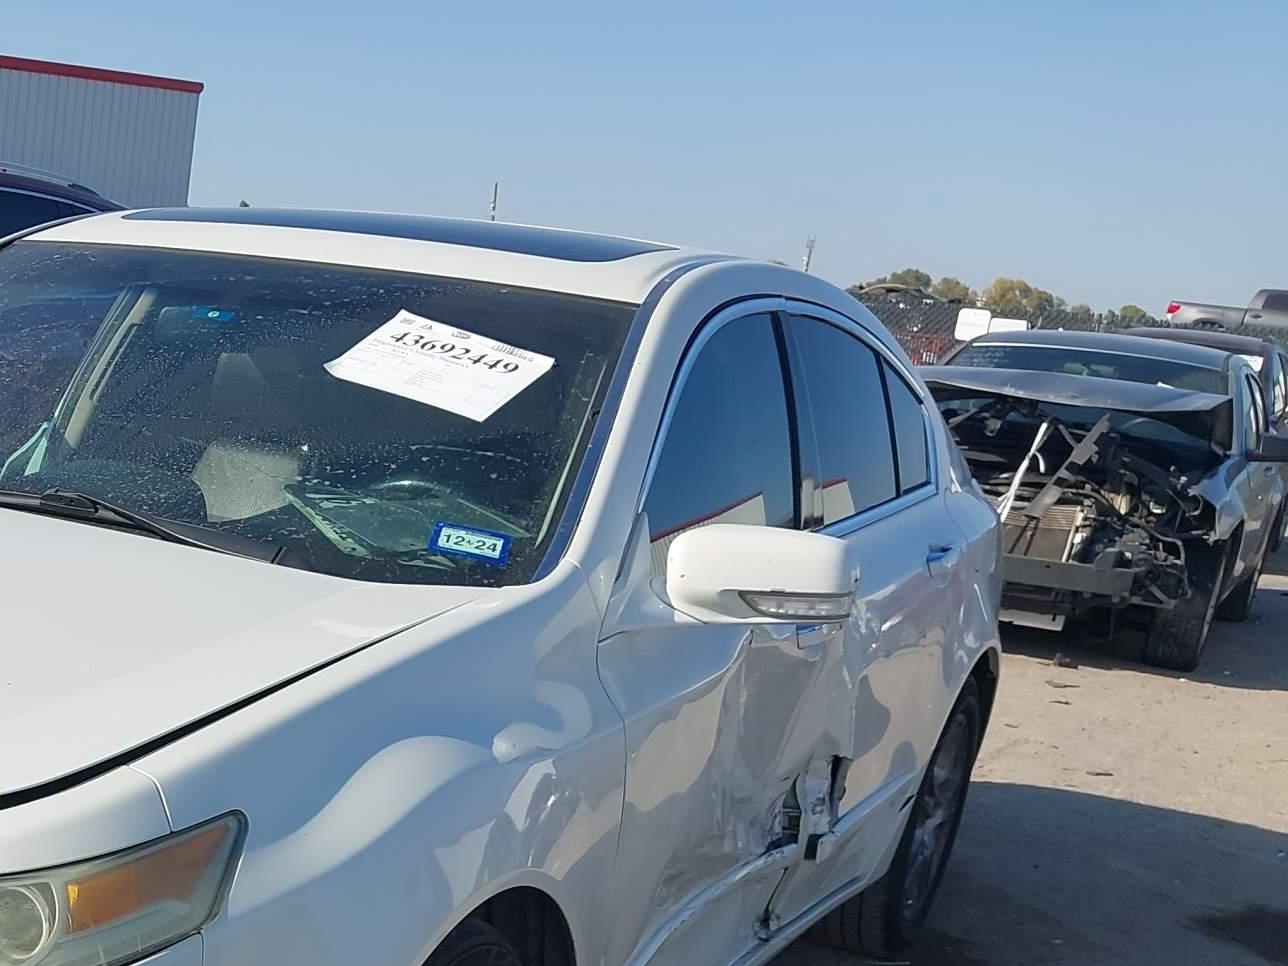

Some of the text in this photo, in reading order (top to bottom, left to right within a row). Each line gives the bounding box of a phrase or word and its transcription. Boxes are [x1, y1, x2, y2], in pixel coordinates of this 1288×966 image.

[389, 331, 520, 374] 43692449
[443, 533, 498, 553] 12 24
